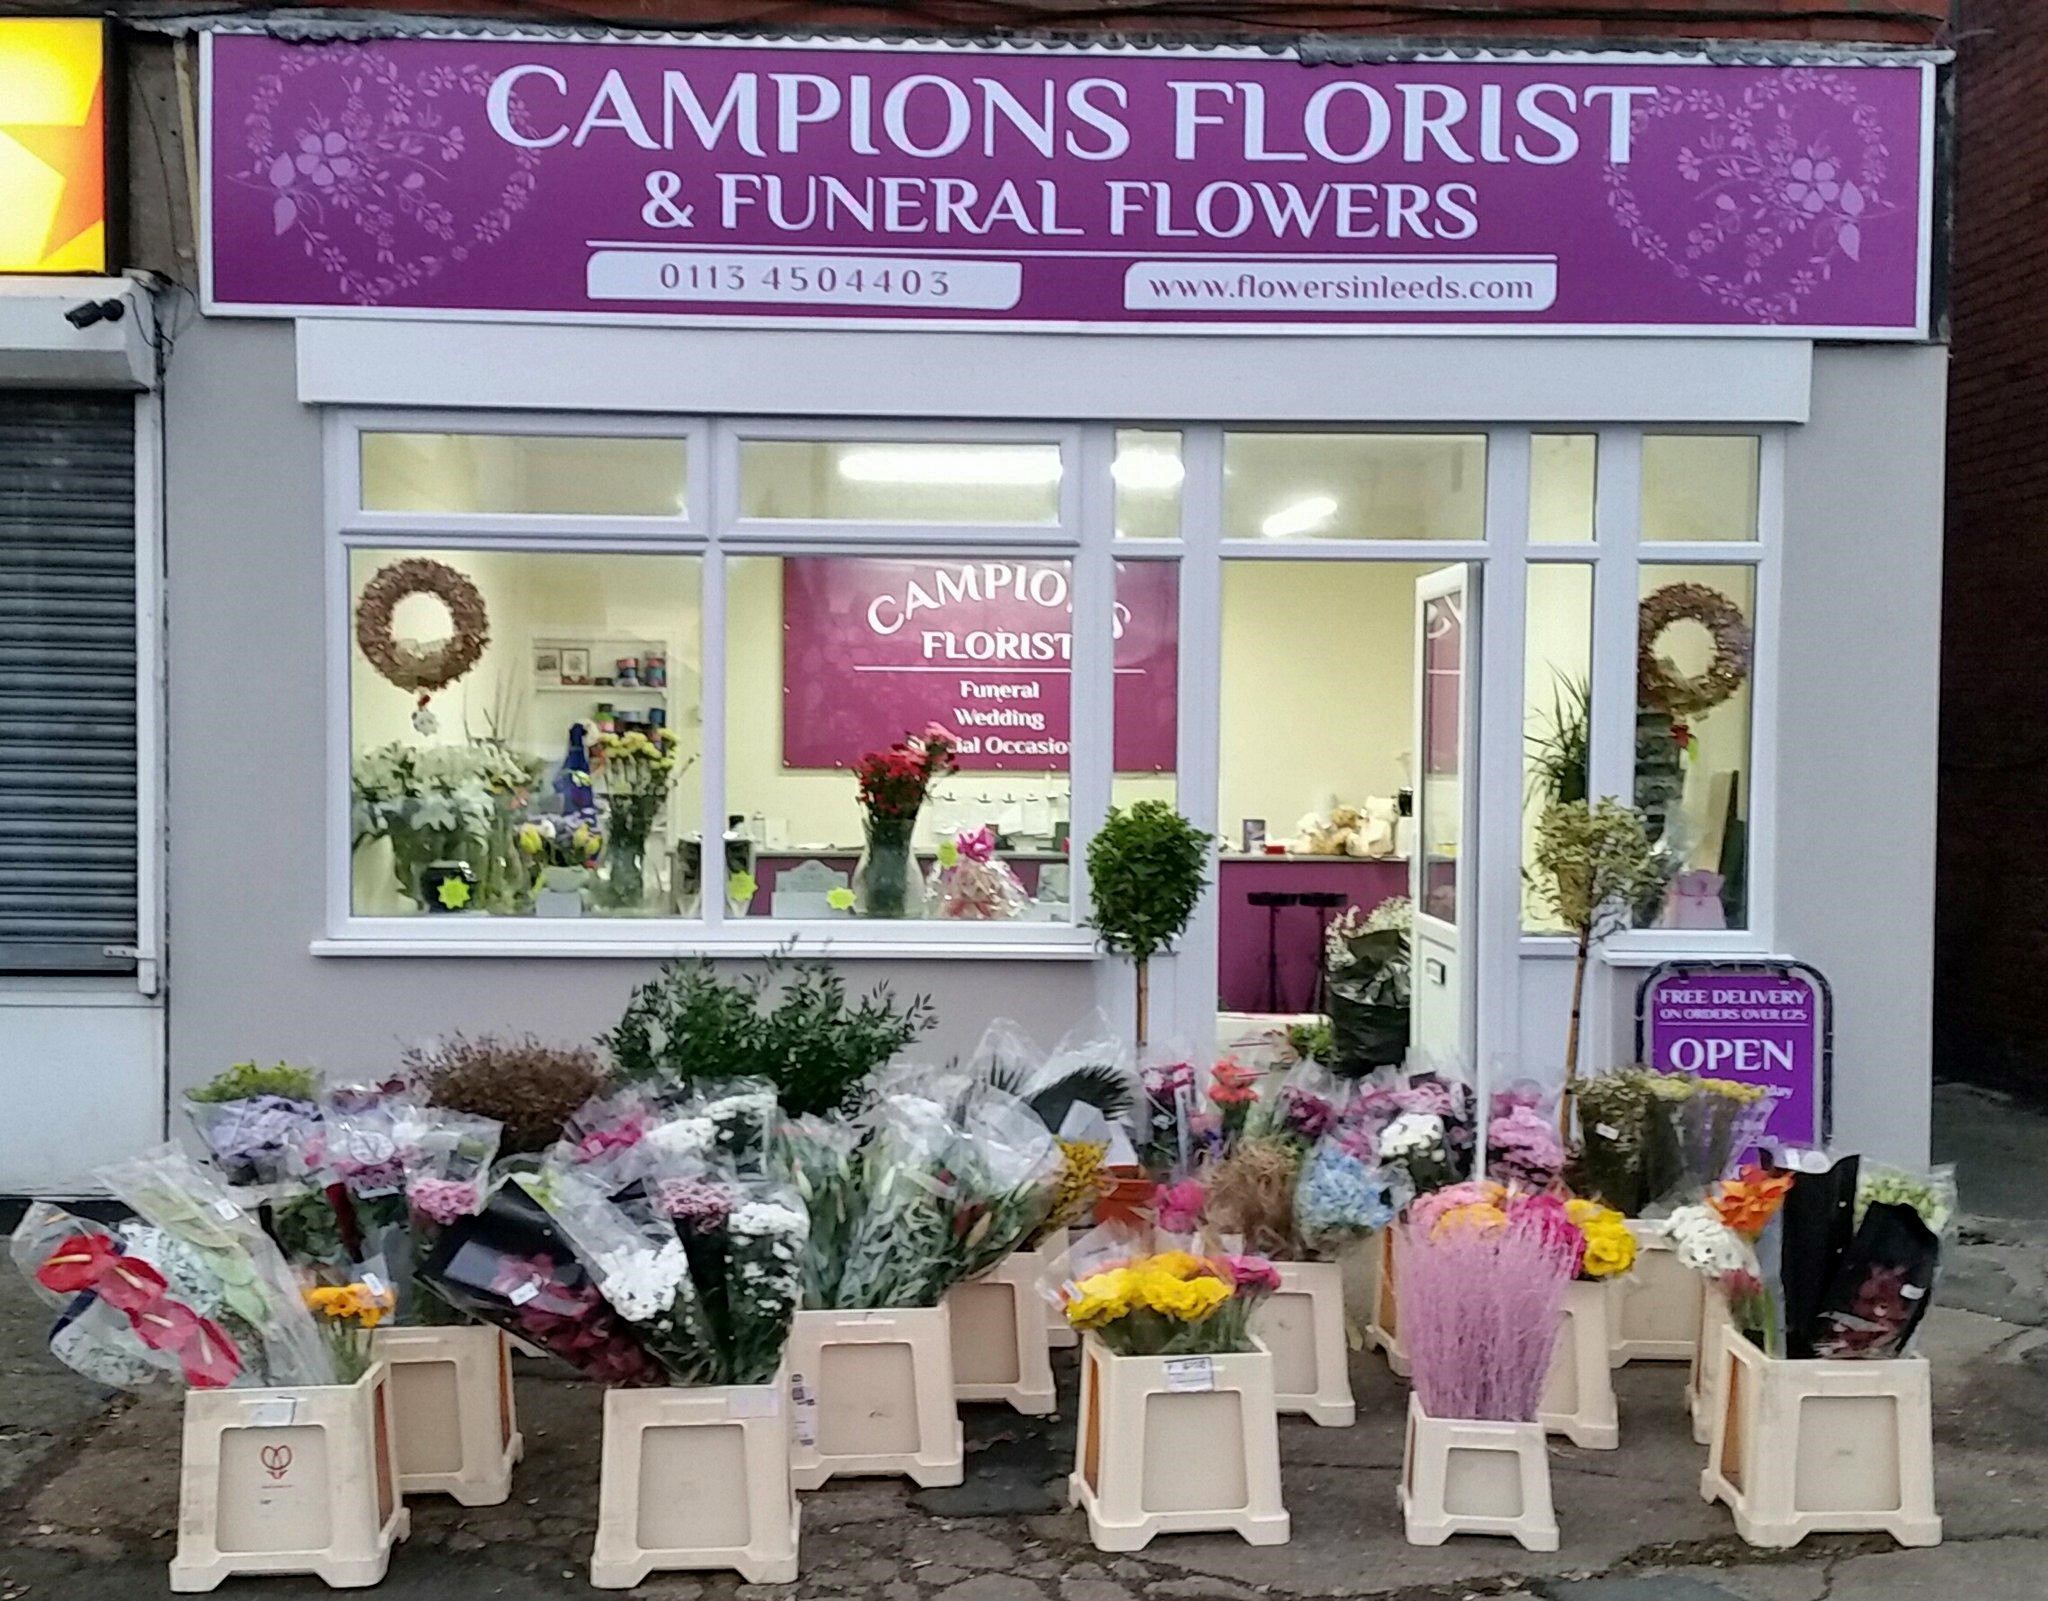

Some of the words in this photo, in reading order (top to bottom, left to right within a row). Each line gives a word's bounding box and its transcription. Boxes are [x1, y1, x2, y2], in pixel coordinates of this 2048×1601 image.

[484, 64, 1130, 160] CAMPIONS
[1166, 80, 1660, 165] FLORIST
[640, 169, 694, 228] &
[714, 172, 1085, 236] FUNERAL
[1104, 179, 1480, 239] FLOWERS
[659, 262, 746, 291] 0113
[761, 265, 951, 296] 4504403
[1147, 273, 1535, 301] www.flowersinleeds.com
[867, 563, 1132, 640] CAMPIOS
[959, 679, 1041, 700] Funeral
[953, 708, 1046, 731] Wedding
[985, 735, 1073, 755] Occasio
[1659, 989, 1709, 1005] FREE
[1711, 989, 1809, 1005] DELIVERY
[1659, 1008, 1682, 1020] ON
[1741, 1008, 1780, 1020] OVER
[1669, 1037, 1794, 1071] OPEN
